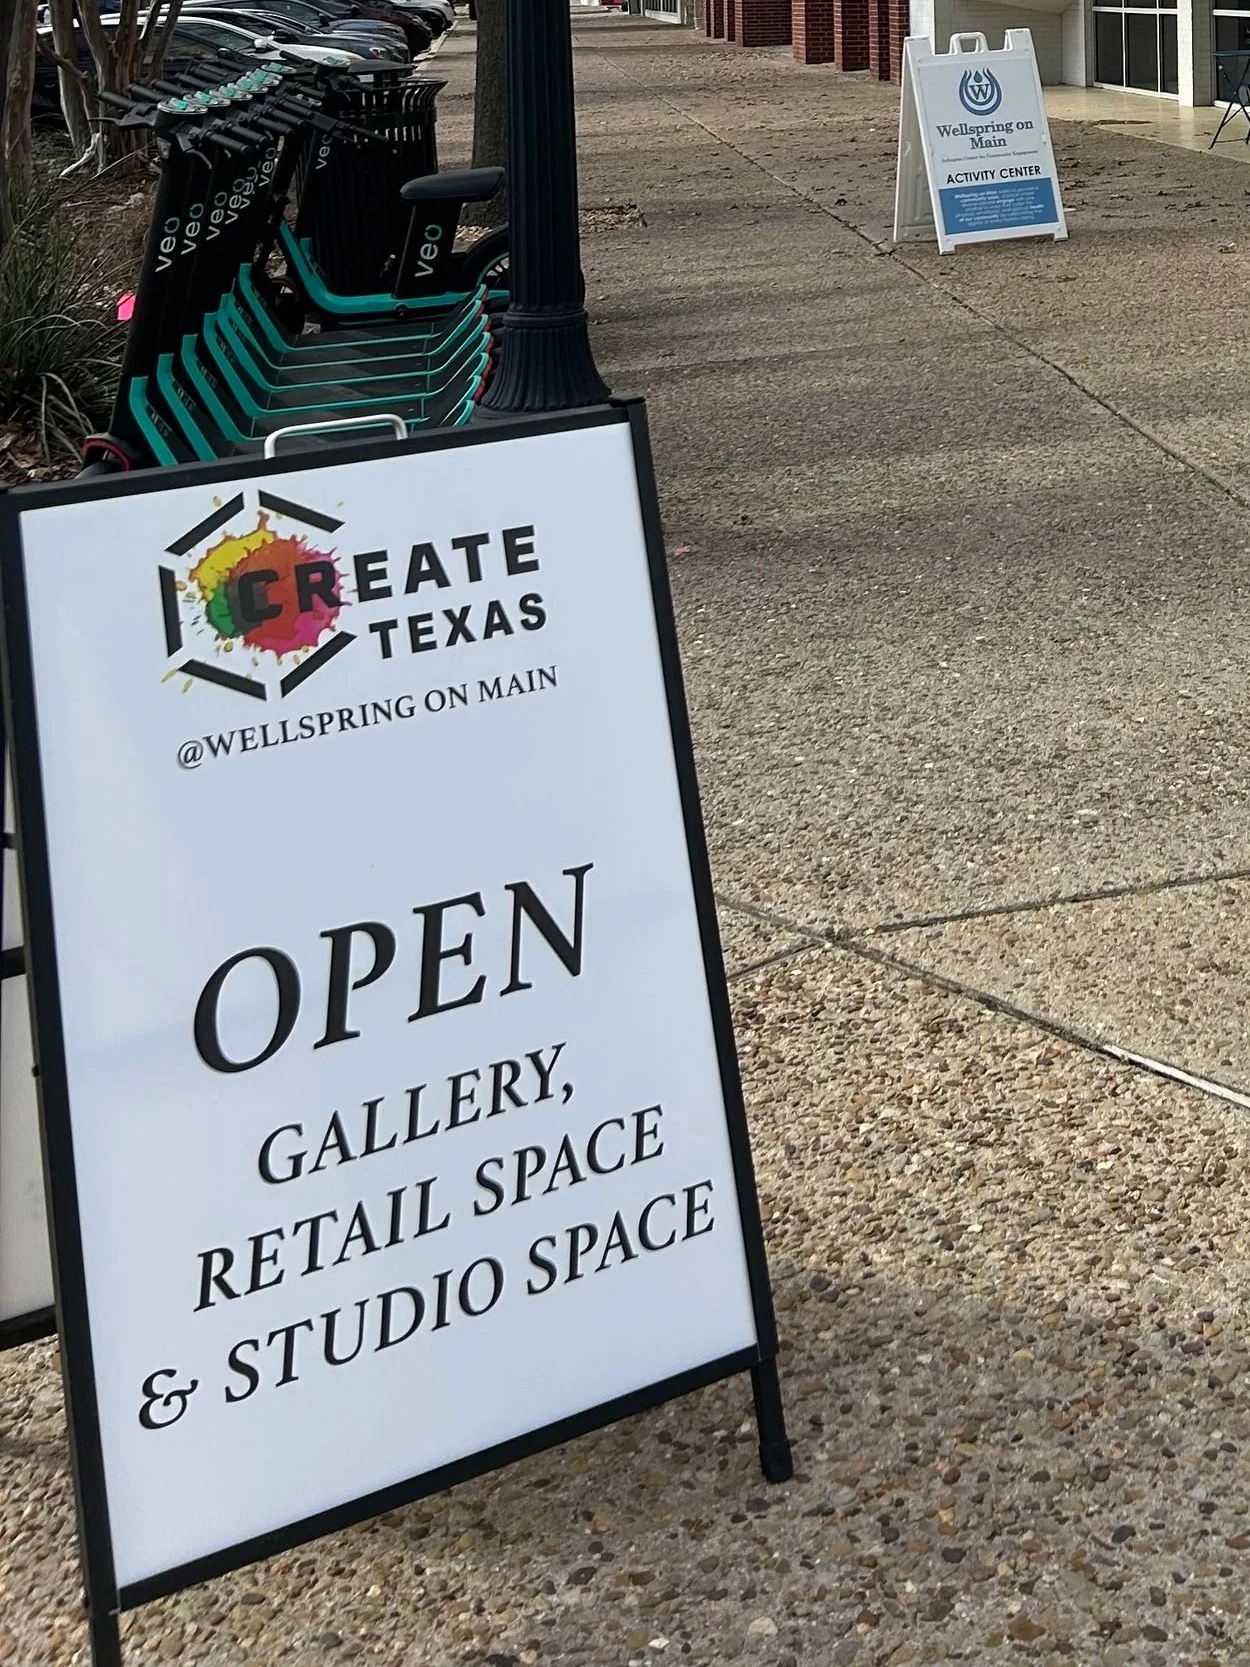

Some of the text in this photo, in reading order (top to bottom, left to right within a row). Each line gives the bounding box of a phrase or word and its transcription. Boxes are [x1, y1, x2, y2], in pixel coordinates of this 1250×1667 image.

[936, 120, 1034, 138] Wellspring on
[970, 137, 1007, 150] Main
[258, 147, 277, 187] veo
[946, 165, 1042, 185] ACTIVITY CENTER
[181, 203, 204, 255] veo
[206, 191, 228, 241] veo
[224, 178, 245, 225] veo
[155, 216, 180, 272] veo
[413, 223, 443, 278] veo
[237, 524, 540, 627] CREATE
[368, 592, 549, 659] TEXAS
[177, 664, 559, 770] @WELLSPRING ON MAIN
[193, 863, 594, 1074] OPEN
[258, 1042, 575, 1186] GALLERY,
[193, 1104, 665, 1312] RETAIL SPACE
[138, 1180, 715, 1430] & STUDIO SPACE
